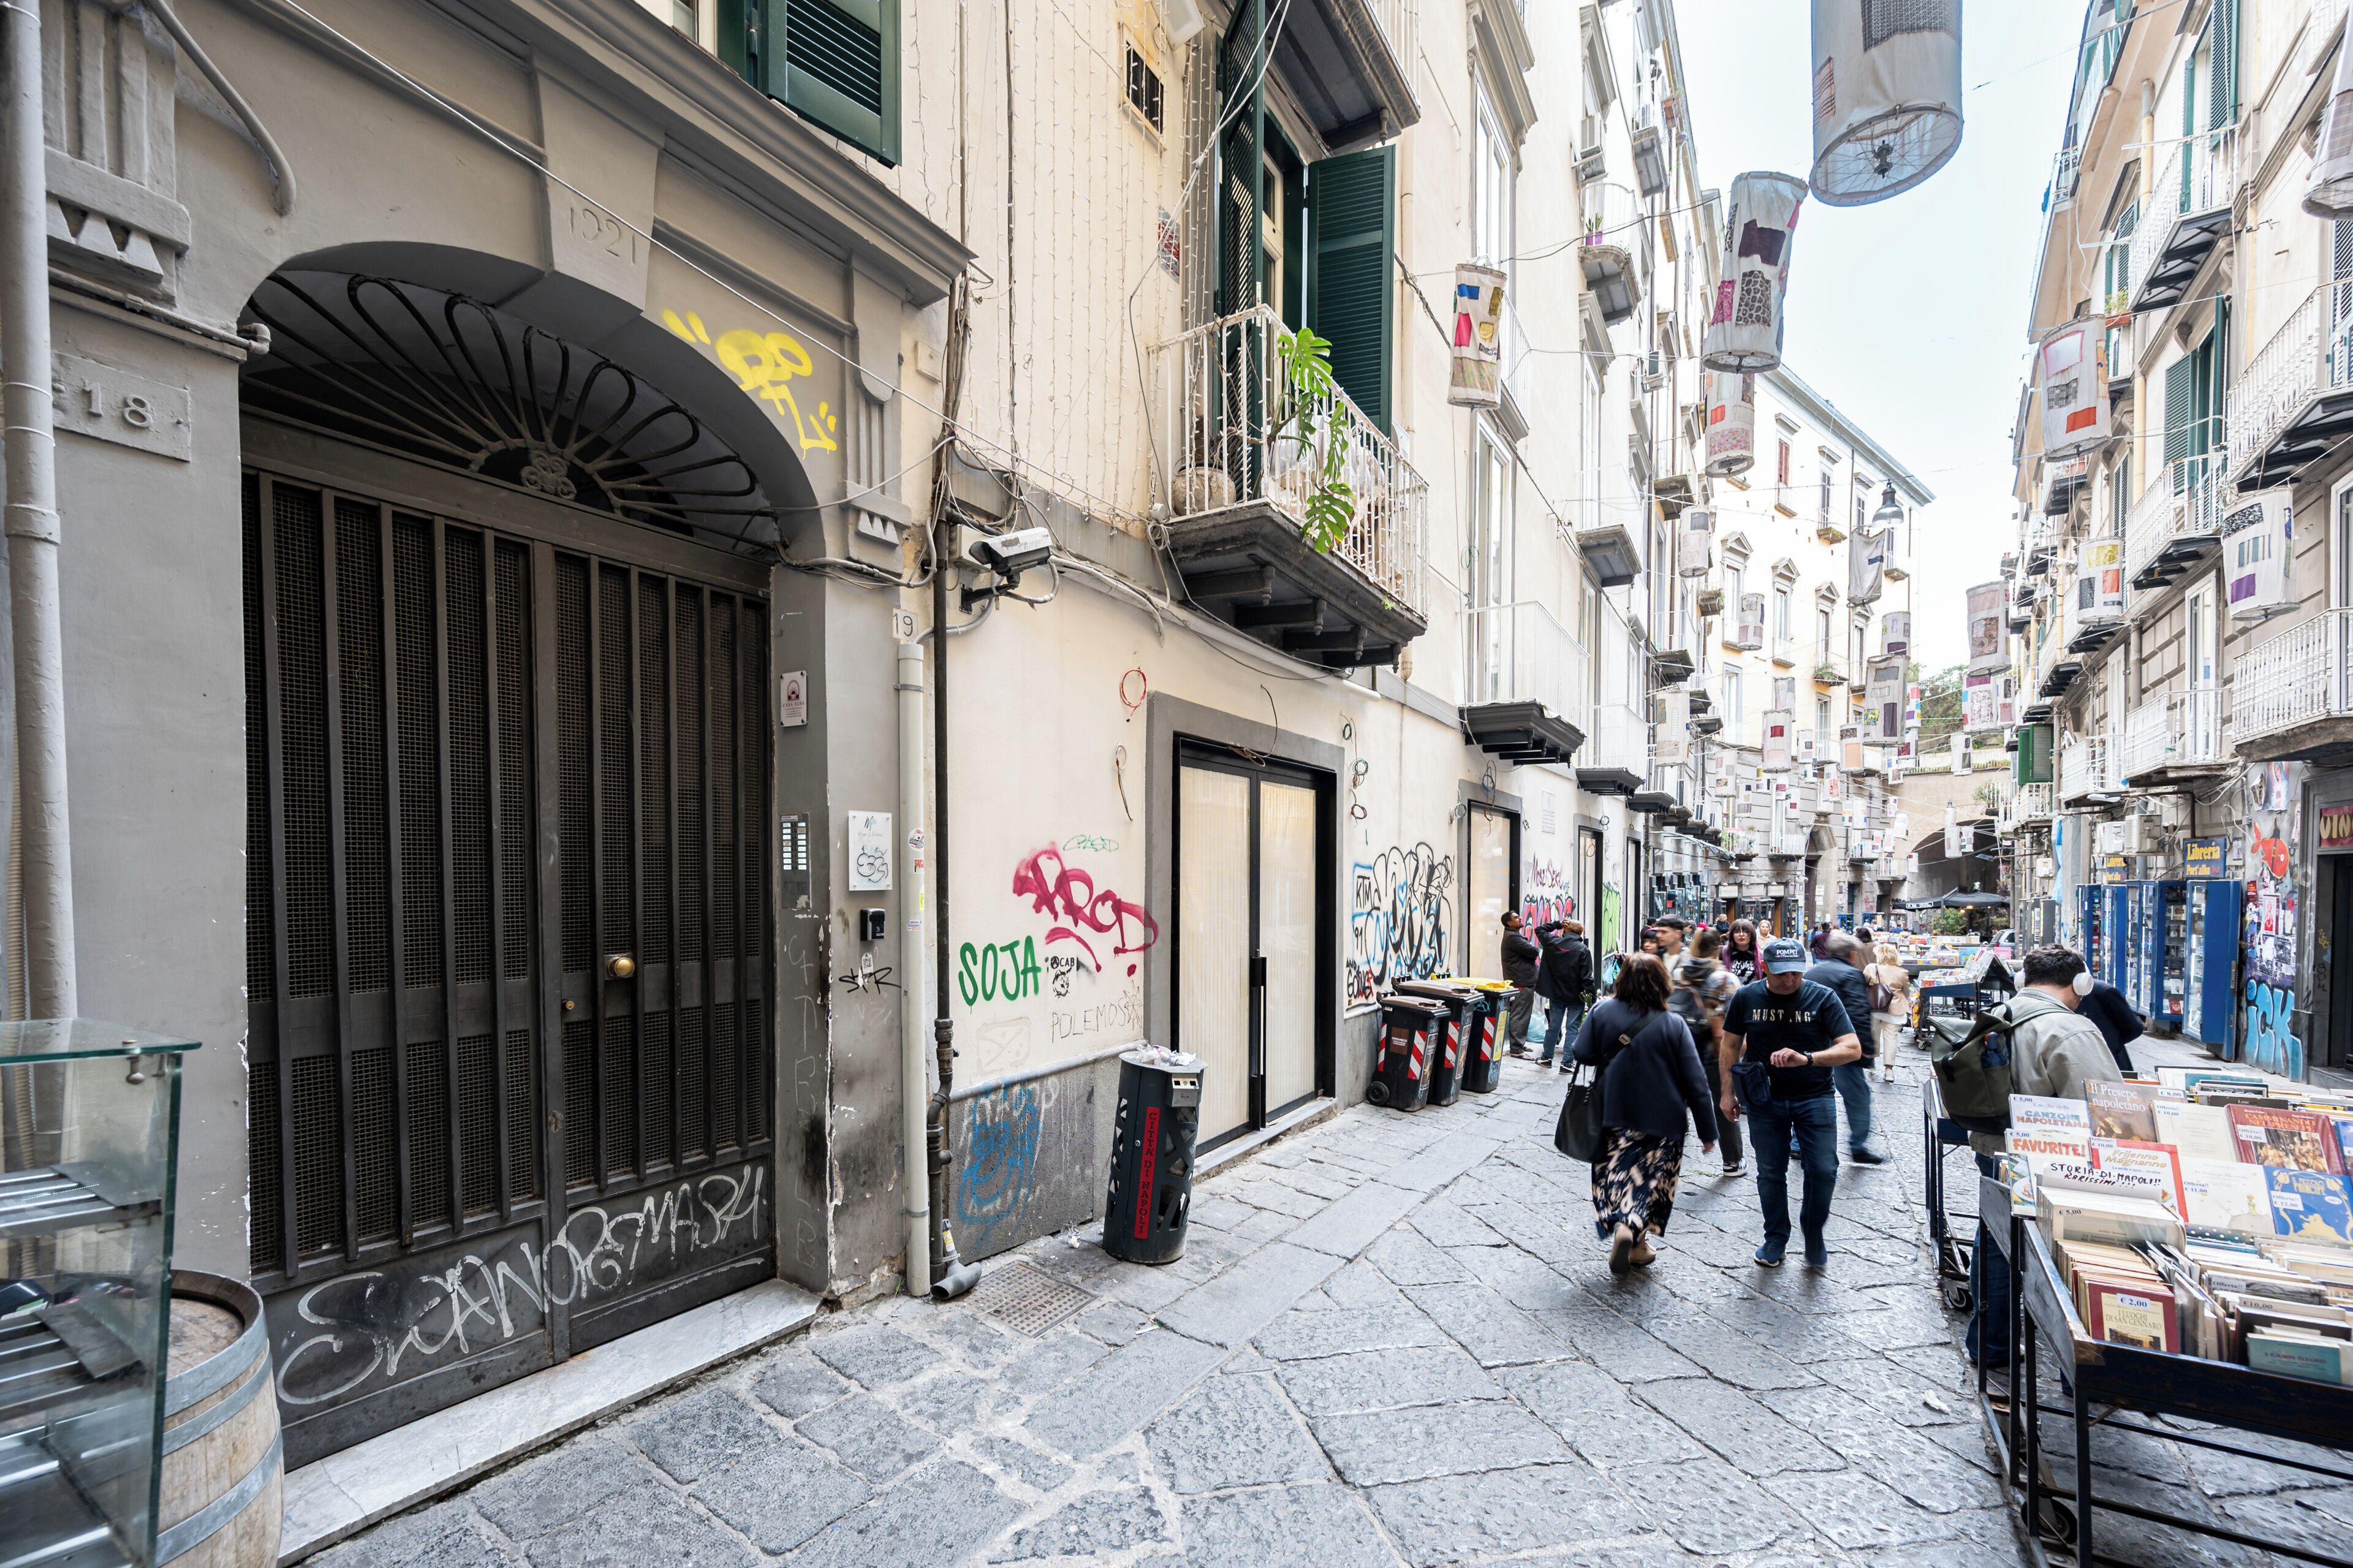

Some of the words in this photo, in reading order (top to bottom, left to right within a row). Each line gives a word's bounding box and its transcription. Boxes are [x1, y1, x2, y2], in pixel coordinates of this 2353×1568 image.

[81, 381, 154, 428] 18
[893, 613, 913, 637] 19
[2320, 813, 2353, 839] VIN
[2186, 842, 2221, 861] Libreria
[1050, 955, 1075, 969] ACAB
[958, 934, 1042, 1007] SOJA
[1752, 1009, 1811, 1023] MUSTNG
[2090, 1083, 2098, 1094] Il
[2100, 1084, 2138, 1103] Presepe
[2092, 1096, 2146, 1113] napoletano
[2016, 1116, 2090, 1128] NAPOLETANA
[2025, 1110, 2081, 1122] CANZONE
[2245, 1113, 2316, 1126] CAMMINANDO
[2012, 1138, 2087, 1157] FAVURITE!
[2104, 1156, 2167, 1169] Magnanno
[2113, 1149, 2158, 1162] Frijenno
[1143, 1159, 1152, 1178] DI
[2050, 1163, 2094, 1176] STORIA
[1138, 1180, 1151, 1234] NAPOLI
[2129, 1298, 2148, 1308] 2,00
[2115, 1316, 2128, 1324] SAN
[2129, 1319, 2162, 1330] GENNARO
[2122, 1311, 2148, 1321] LUOGHI
